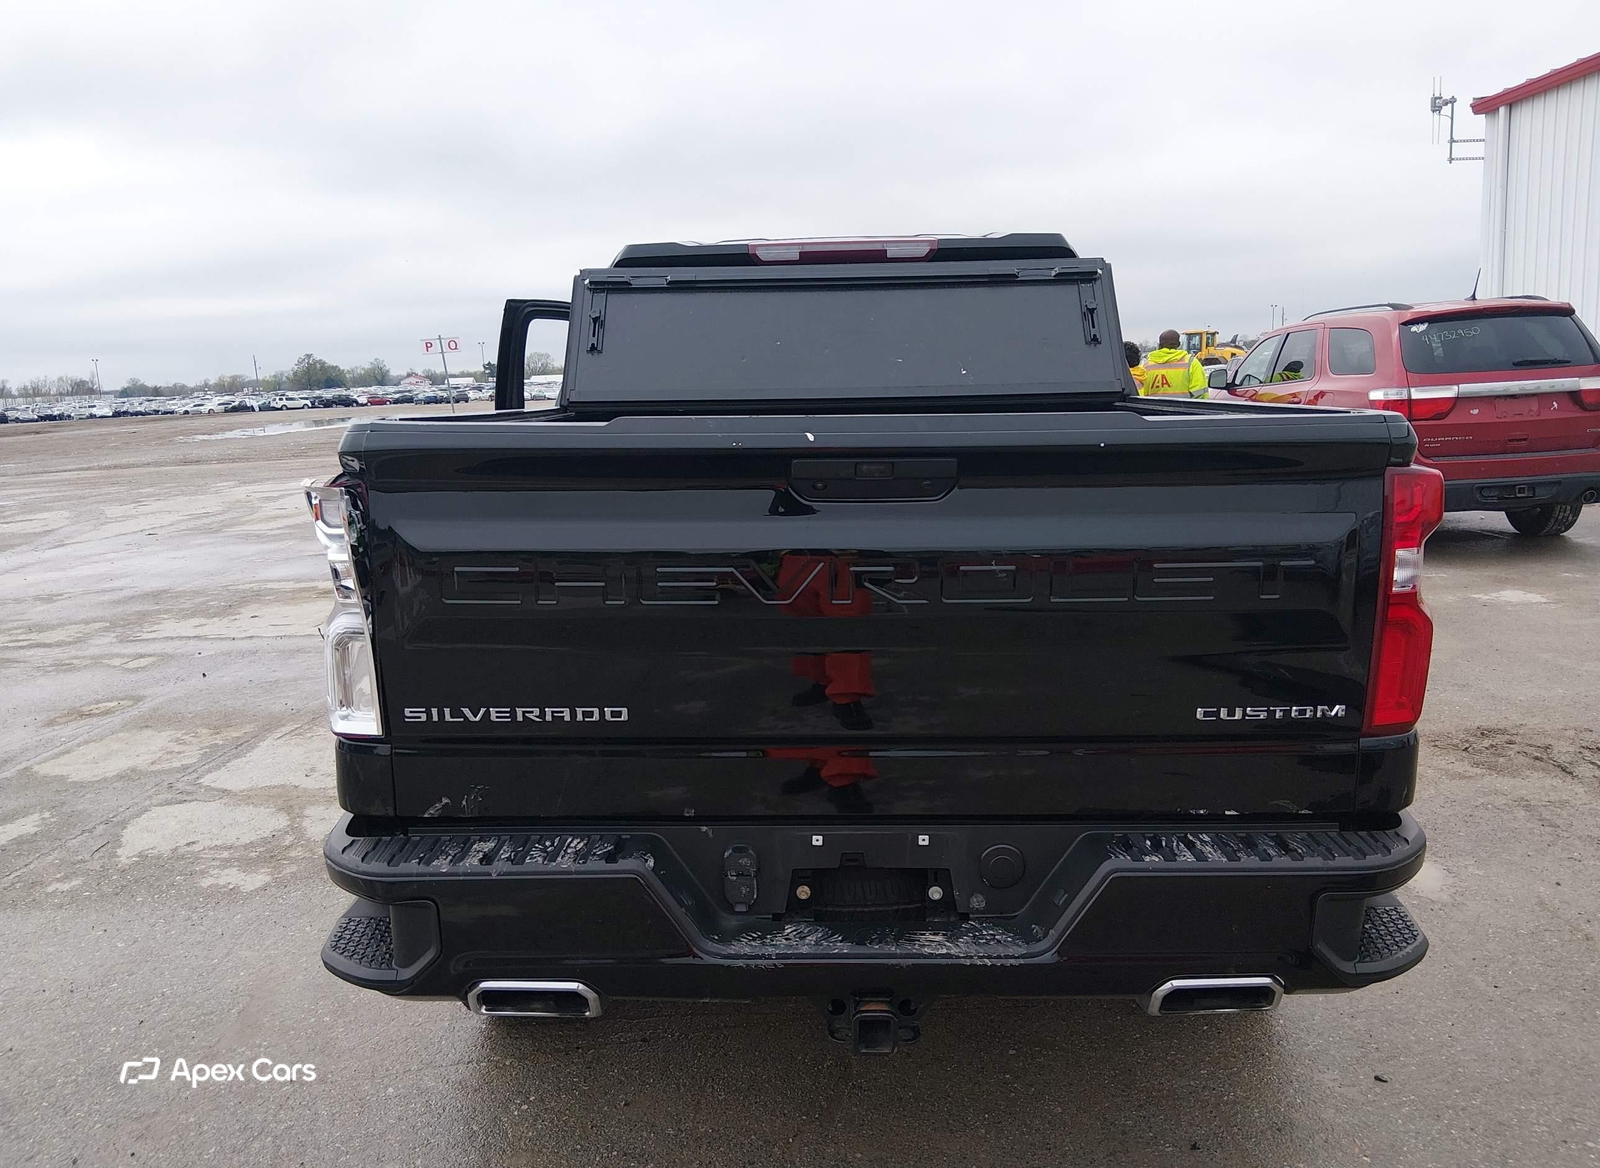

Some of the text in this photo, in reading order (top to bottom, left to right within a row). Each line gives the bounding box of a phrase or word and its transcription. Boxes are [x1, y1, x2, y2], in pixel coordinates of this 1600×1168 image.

[425, 341, 433, 352] P
[447, 340, 459, 351] Q
[438, 557, 1317, 605] CHEVROLET
[404, 707, 629, 722] SILVERADO
[1196, 704, 1346, 720] CUSTOM
